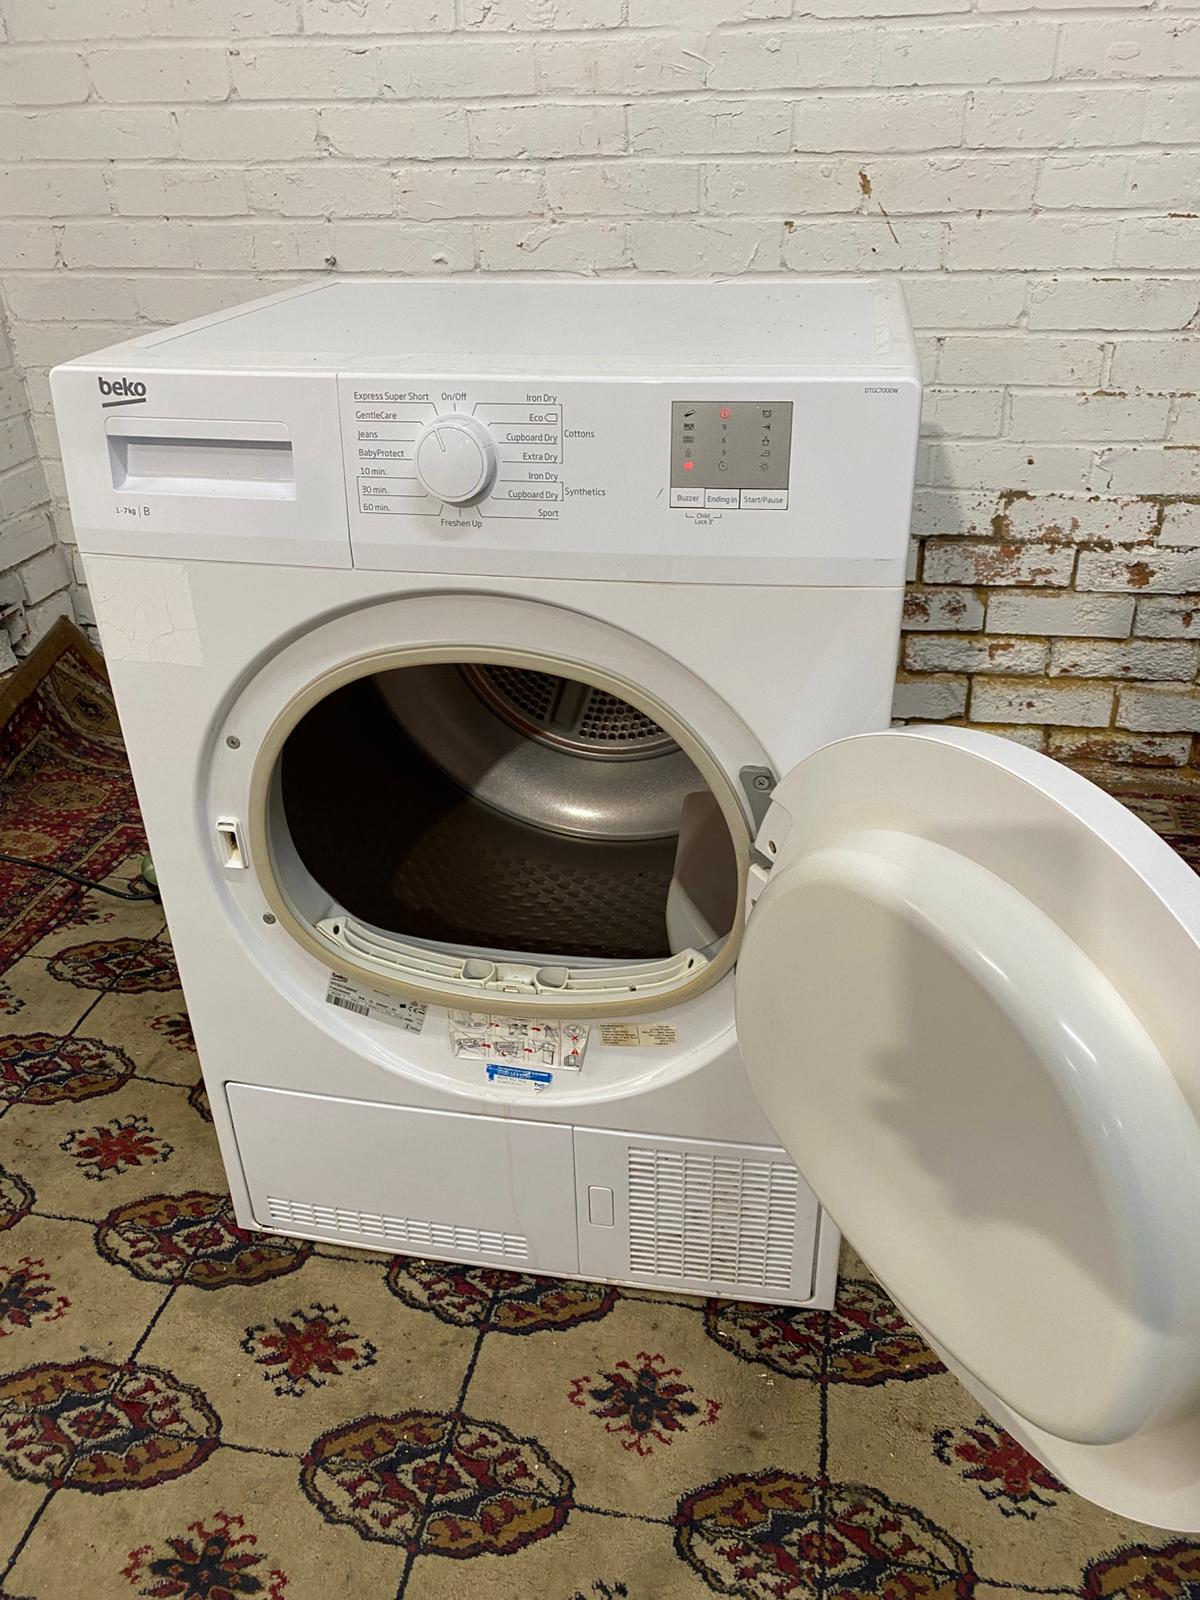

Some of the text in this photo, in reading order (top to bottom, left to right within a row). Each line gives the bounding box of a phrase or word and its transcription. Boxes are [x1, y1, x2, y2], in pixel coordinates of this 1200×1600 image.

[98, 377, 146, 396] beko
[353, 392, 429, 402] Express Super Short
[441, 392, 467, 401] On/Off
[526, 393, 557, 404] Iron Dry
[355, 411, 398, 419] GentleCare
[529, 413, 544, 422] Eco
[357, 430, 379, 440] Jeans
[506, 432, 558, 444] Cupboard Dry
[564, 429, 595, 438] Cottons
[358, 448, 405, 458] BabyProtect
[522, 452, 558, 463] Extra Dry
[360, 467, 388, 475] 10 min.
[528, 471, 559, 482] Iron Dry
[361, 485, 389, 494] 30 min.
[564, 487, 607, 497] Synthetics
[507, 489, 559, 501] Cupboard Dry
[677, 494, 700, 502] Buzzer
[707, 495, 738, 504] Ending In
[743, 496, 784, 504] Start/Pause
[143, 506, 150, 516] B
[363, 503, 391, 512] 60 min.
[537, 508, 559, 518] Sport
[440, 518, 483, 528] Freshen Up
